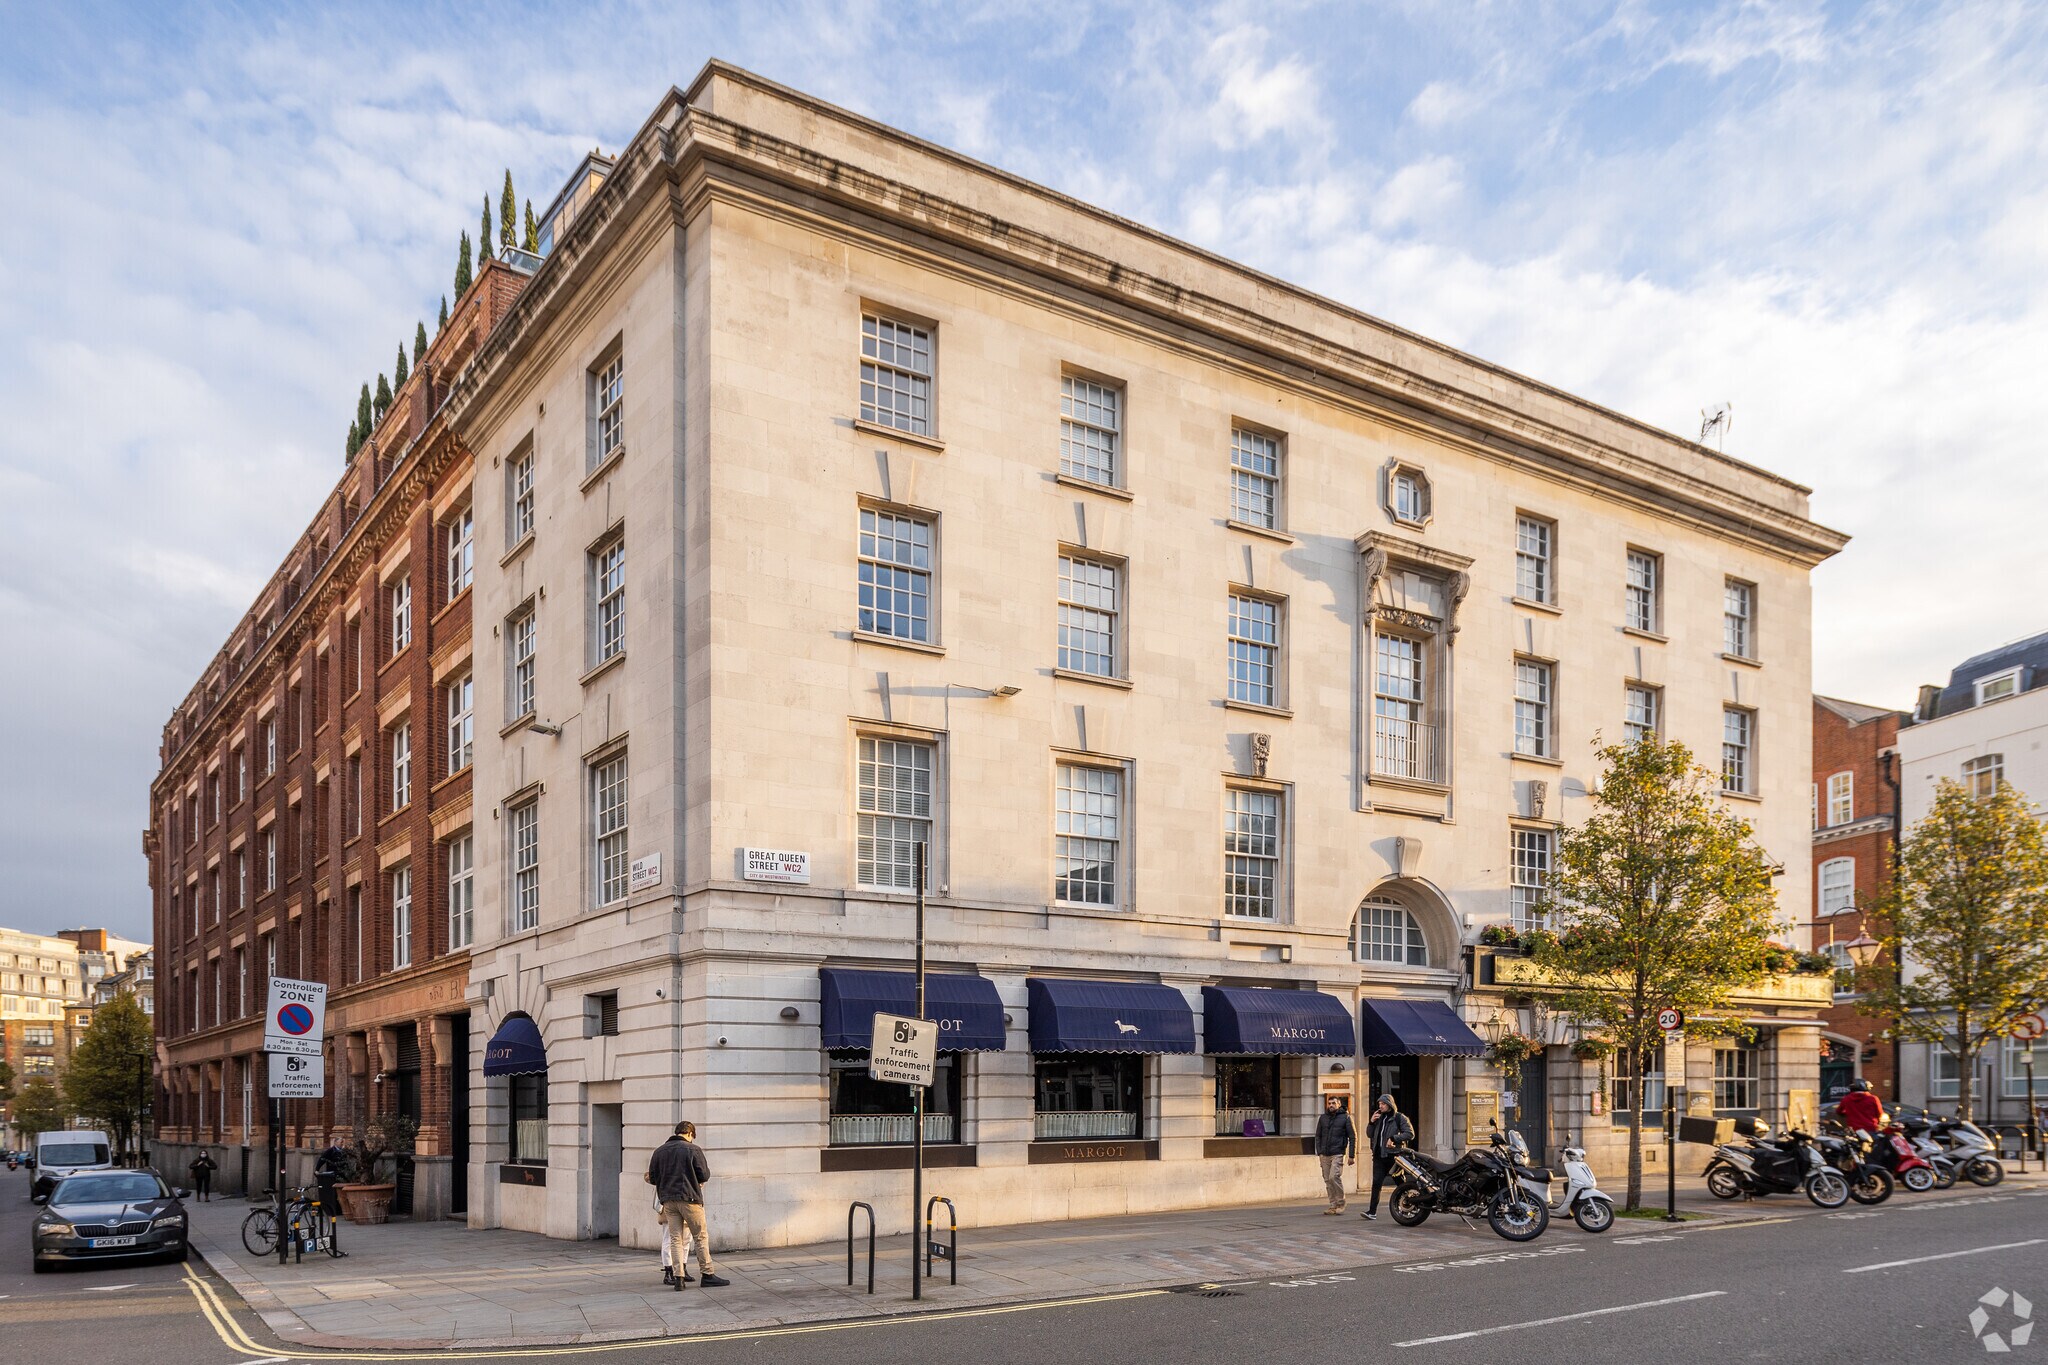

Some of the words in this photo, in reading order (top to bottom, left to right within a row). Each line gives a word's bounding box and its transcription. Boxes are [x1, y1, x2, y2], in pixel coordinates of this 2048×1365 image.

[749, 850, 775, 860] GREAT
[778, 853, 806, 863] QUEEN
[632, 861, 643, 872] WILD
[632, 869, 647, 881] STREET
[647, 865, 658, 876] WC2
[749, 860, 779, 871] STREET
[783, 863, 802, 873] WC2
[273, 980, 323, 993] Controlled
[280, 990, 315, 1003] ZONE
[1660, 1014, 1677, 1024] 20
[1270, 1026, 1326, 1040] MARGOT
[889, 1046, 919, 1059] Traffic
[874, 1056, 931, 1072] enforcement
[883, 1069, 921, 1081] cameras
[1064, 1146, 1125, 1159] MARGOT
[306, 1240, 314, 1251] P
[1269, 1276, 1356, 1288] SOLO
